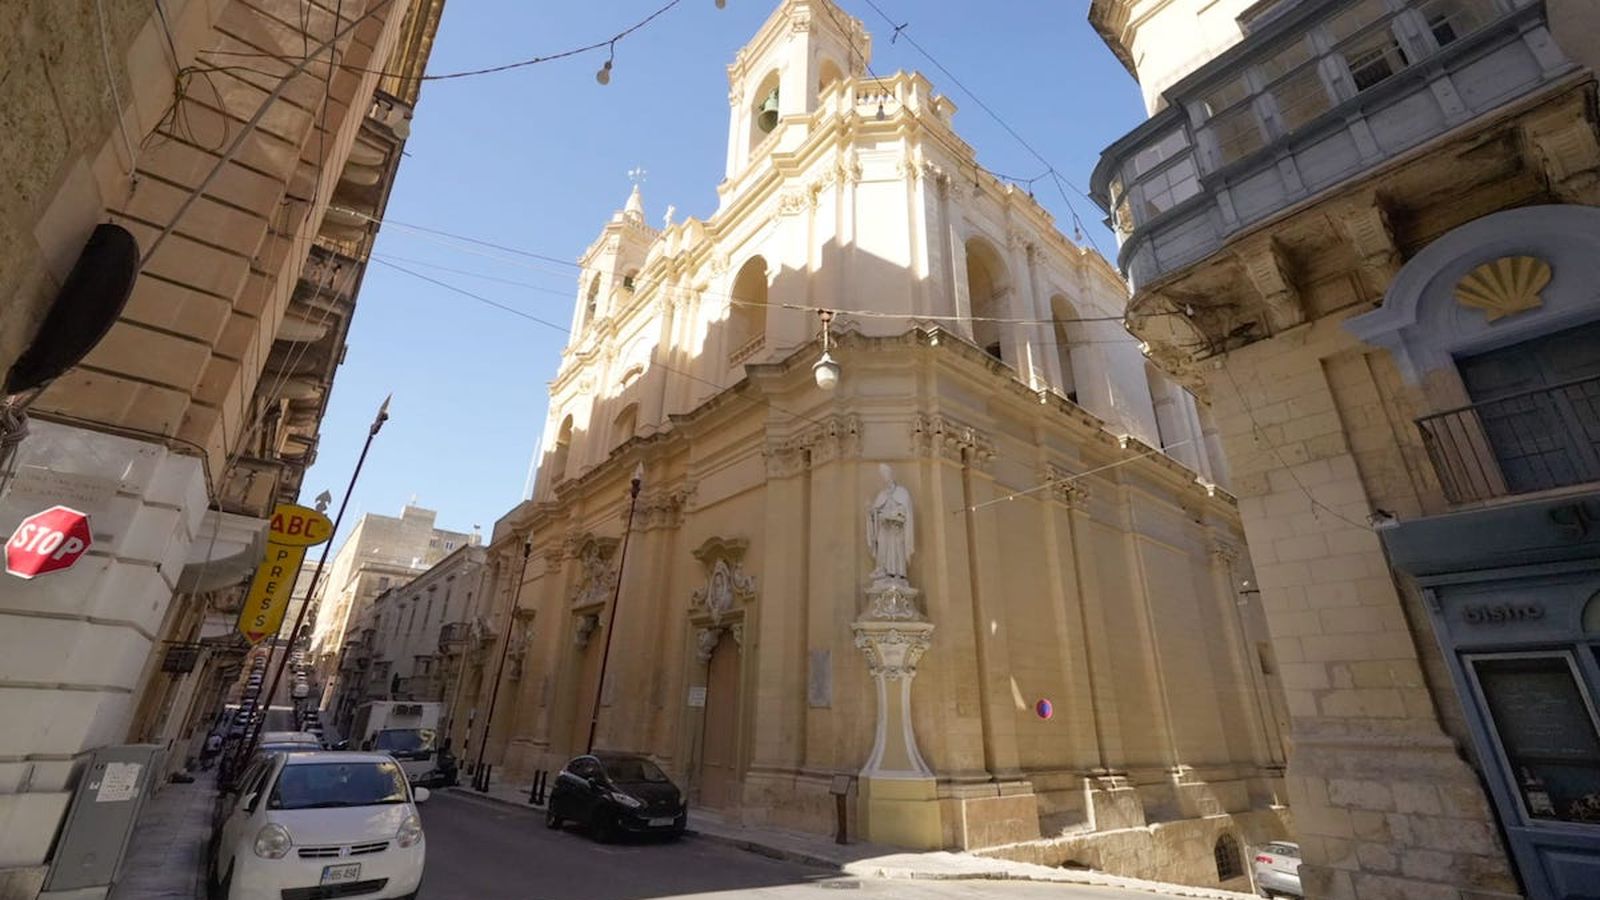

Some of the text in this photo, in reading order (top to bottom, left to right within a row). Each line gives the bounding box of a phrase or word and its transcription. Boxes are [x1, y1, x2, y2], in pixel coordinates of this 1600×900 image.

[13, 523, 84, 560] STOP
[270, 513, 321, 538] ABC
[255, 550, 288, 627] PRESS
